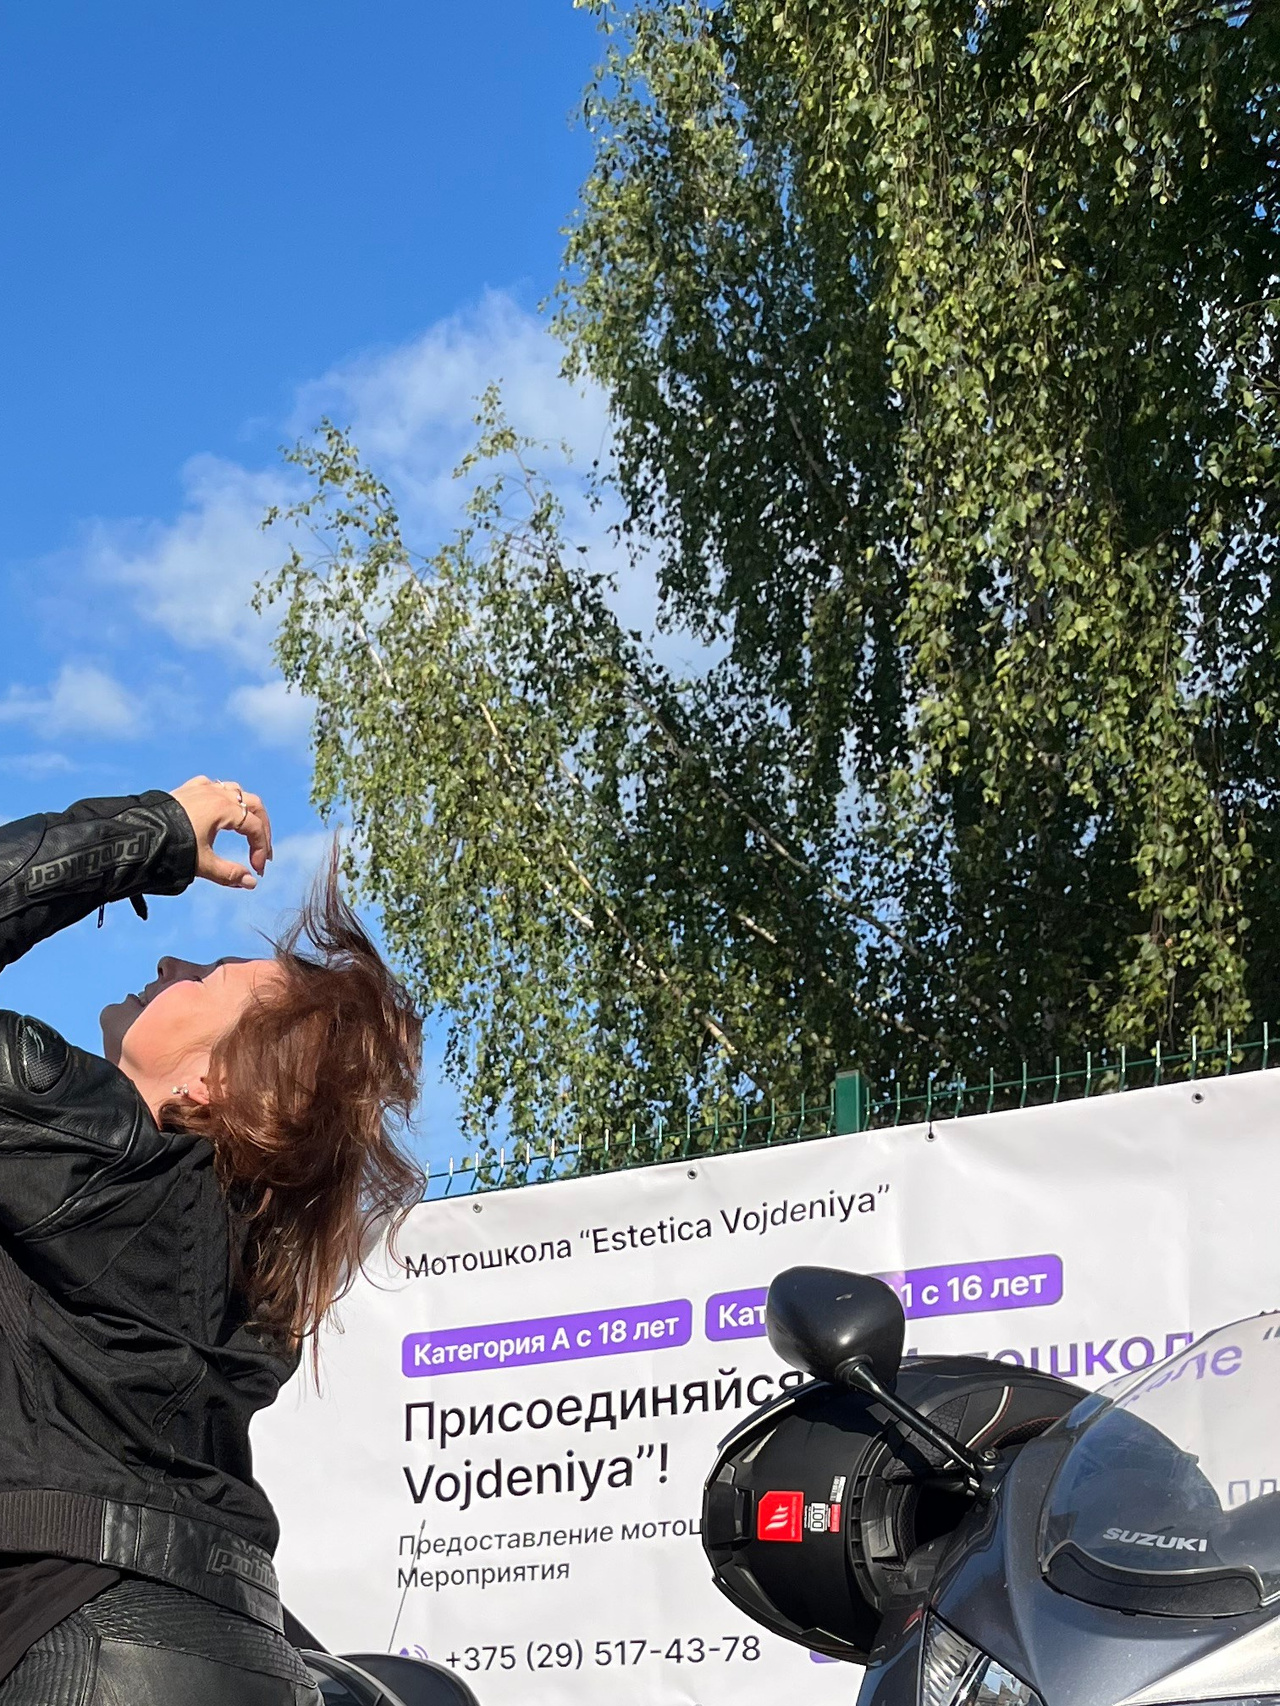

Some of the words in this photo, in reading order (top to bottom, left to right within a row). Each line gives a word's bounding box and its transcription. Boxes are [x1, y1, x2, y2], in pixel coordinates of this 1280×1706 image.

[405, 1240, 572, 1280] Мотошкола
[580, 1216, 712, 1254] “Estetica
[719, 1184, 890, 1236] Vojdeniya”
[921, 1285, 939, 1305] с
[946, 1274, 983, 1303] 16
[990, 1273, 1048, 1299] лет
[414, 1335, 545, 1367] Категория
[576, 1329, 592, 1348] с
[598, 1319, 627, 1345] 18
[632, 1317, 680, 1341] лет
[406, 1367, 805, 1450] Присоединяйся
[403, 1442, 668, 1511] Vojdeniya”!
[812, 1505, 824, 1529] DOT
[400, 1525, 614, 1559] Предоставление
[621, 1518, 703, 1541] мотоц
[1102, 1527, 1208, 1552] SUZUKI
[398, 1563, 570, 1591] Мероприятия
[445, 1645, 516, 1671] +375
[526, 1640, 583, 1671] (29)
[595, 1636, 761, 1666] 517-43-78
